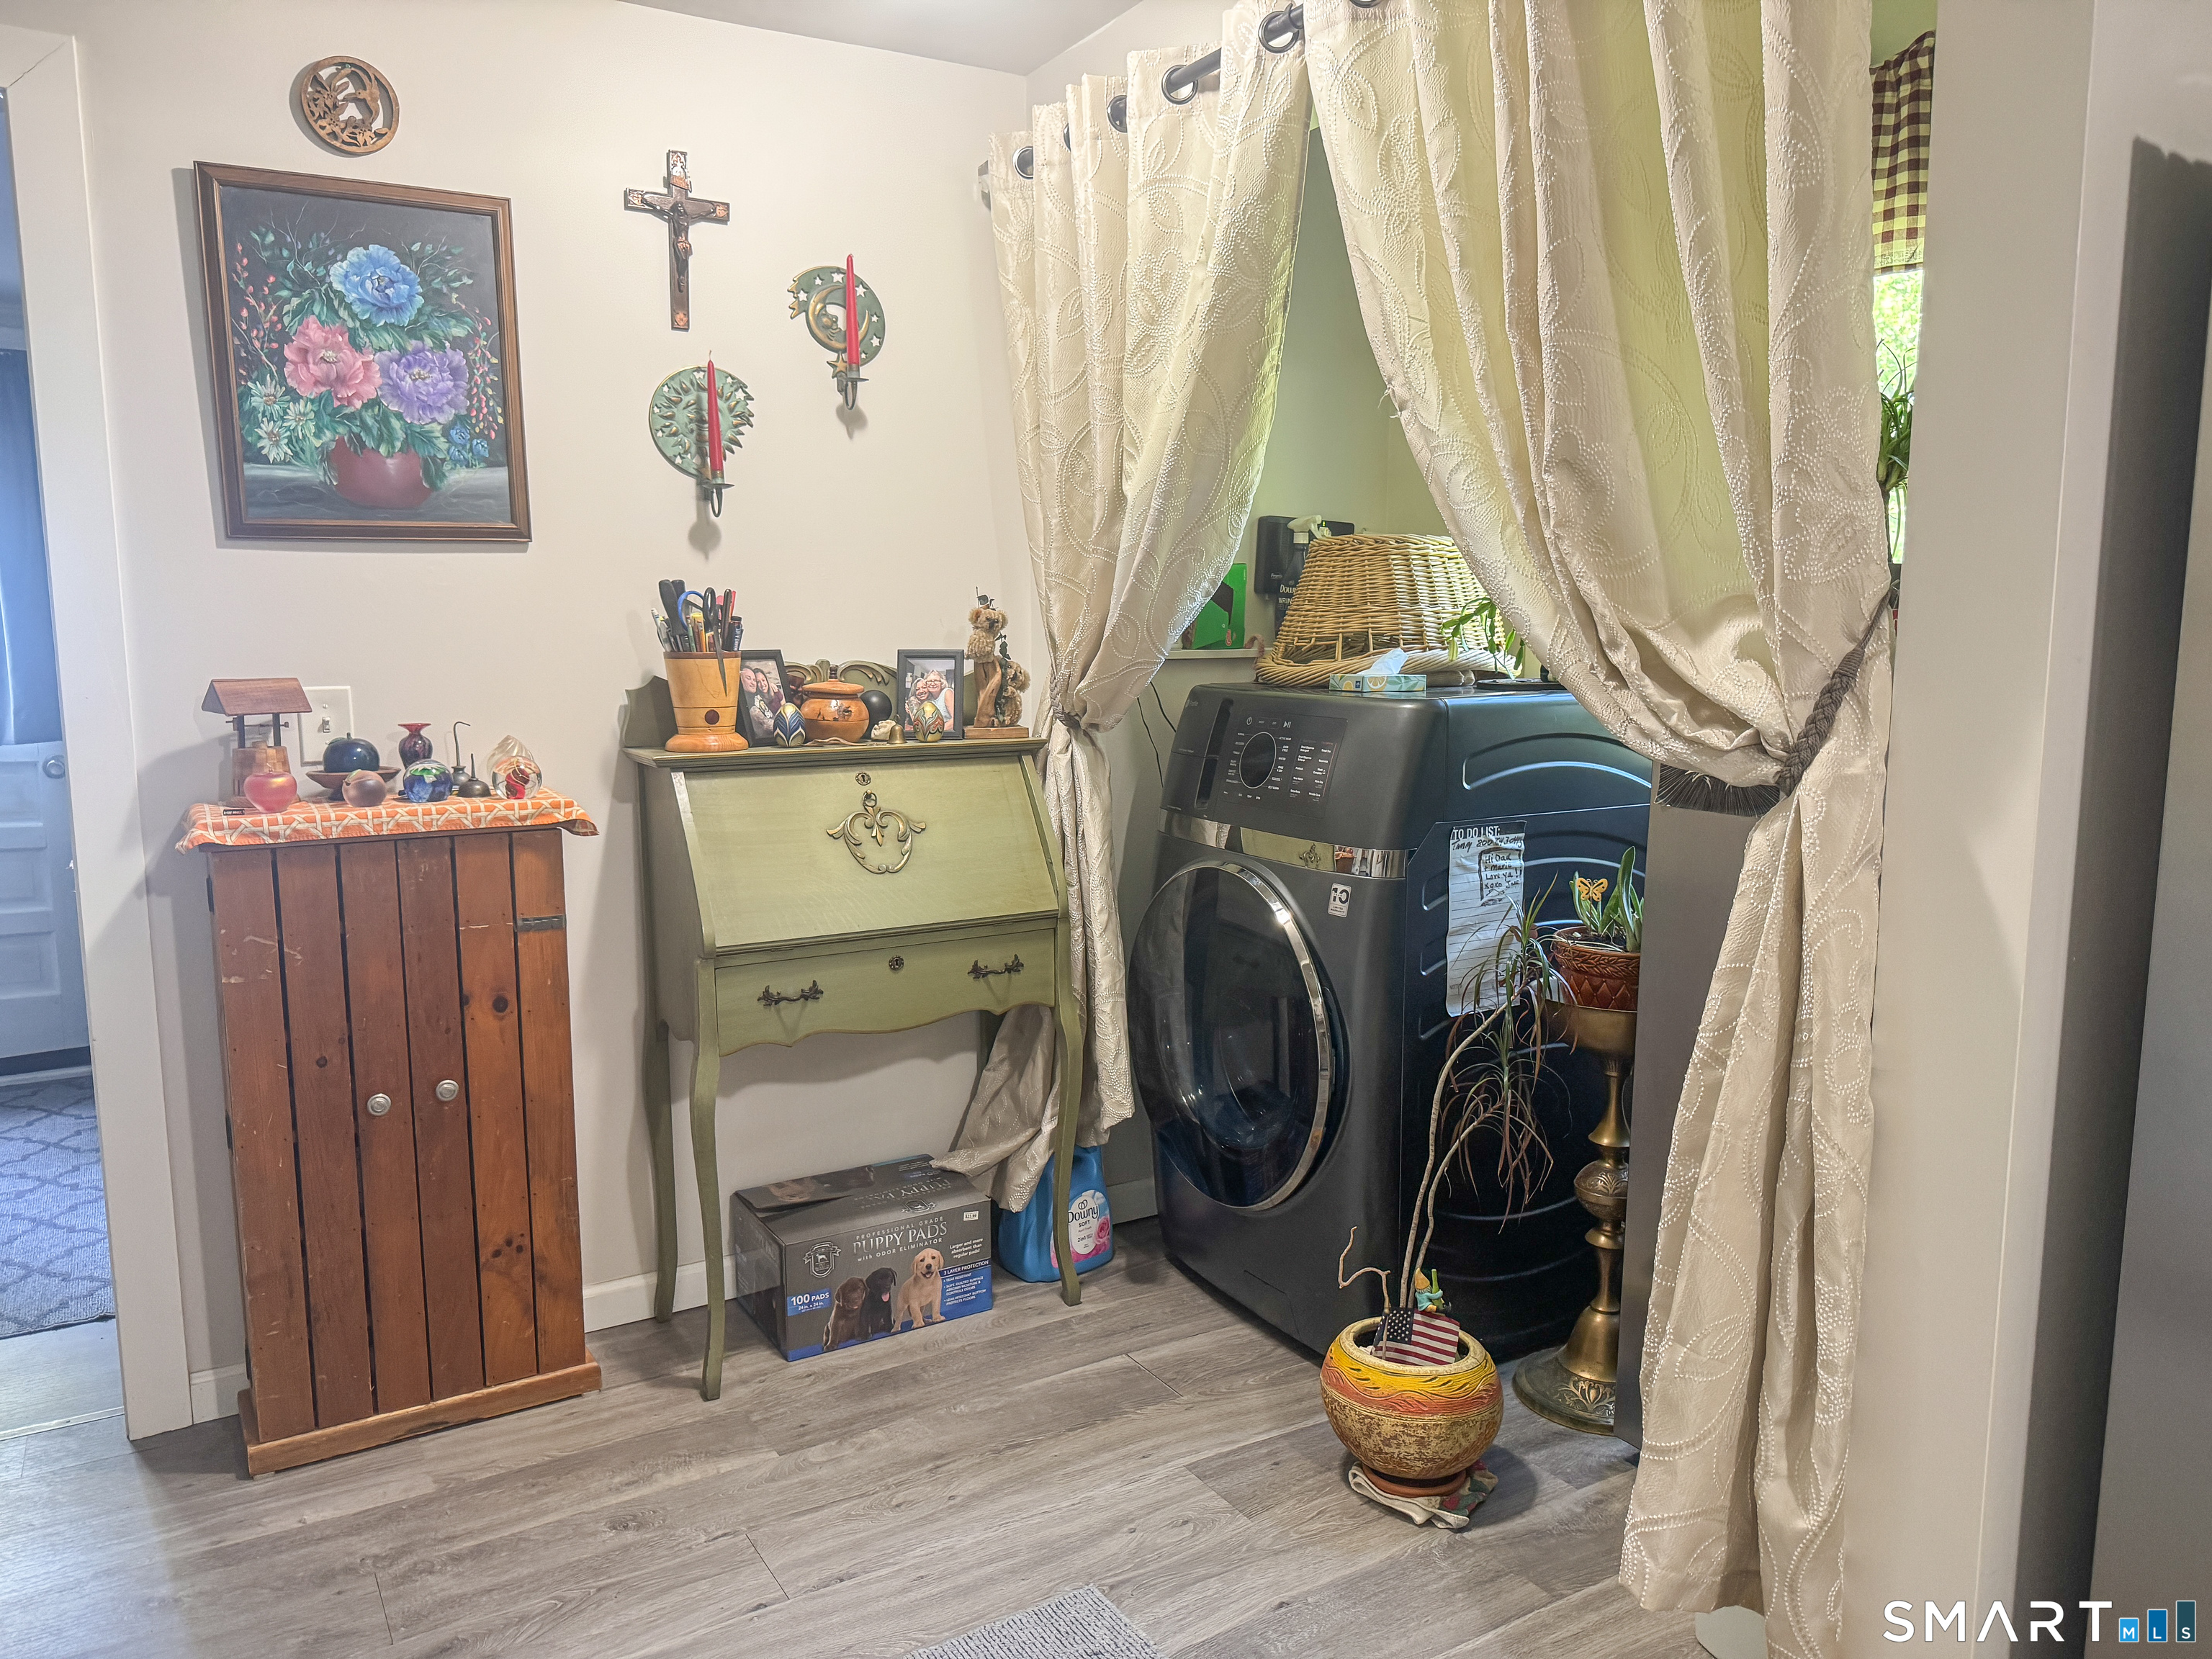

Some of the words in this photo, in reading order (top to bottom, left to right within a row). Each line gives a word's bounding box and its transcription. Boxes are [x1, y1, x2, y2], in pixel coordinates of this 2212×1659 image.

[1453, 830, 1464, 840] TO
[1467, 828, 1478, 839] DO
[1485, 854, 1493, 863] Hi
[1332, 887, 1349, 904] 10
[856, 1224, 914, 1240] PROFESSIONAL
[919, 1216, 944, 1226] GRADE
[853, 1231, 904, 1254] PUPPY
[909, 1221, 948, 1243] PADS
[876, 1249, 896, 1257] ODOR
[899, 1238, 943, 1252] ELIMINATOR
[961, 1260, 989, 1271] PROTECTION
[791, 1294, 810, 1305] 100
[811, 1292, 830, 1301] PADS
